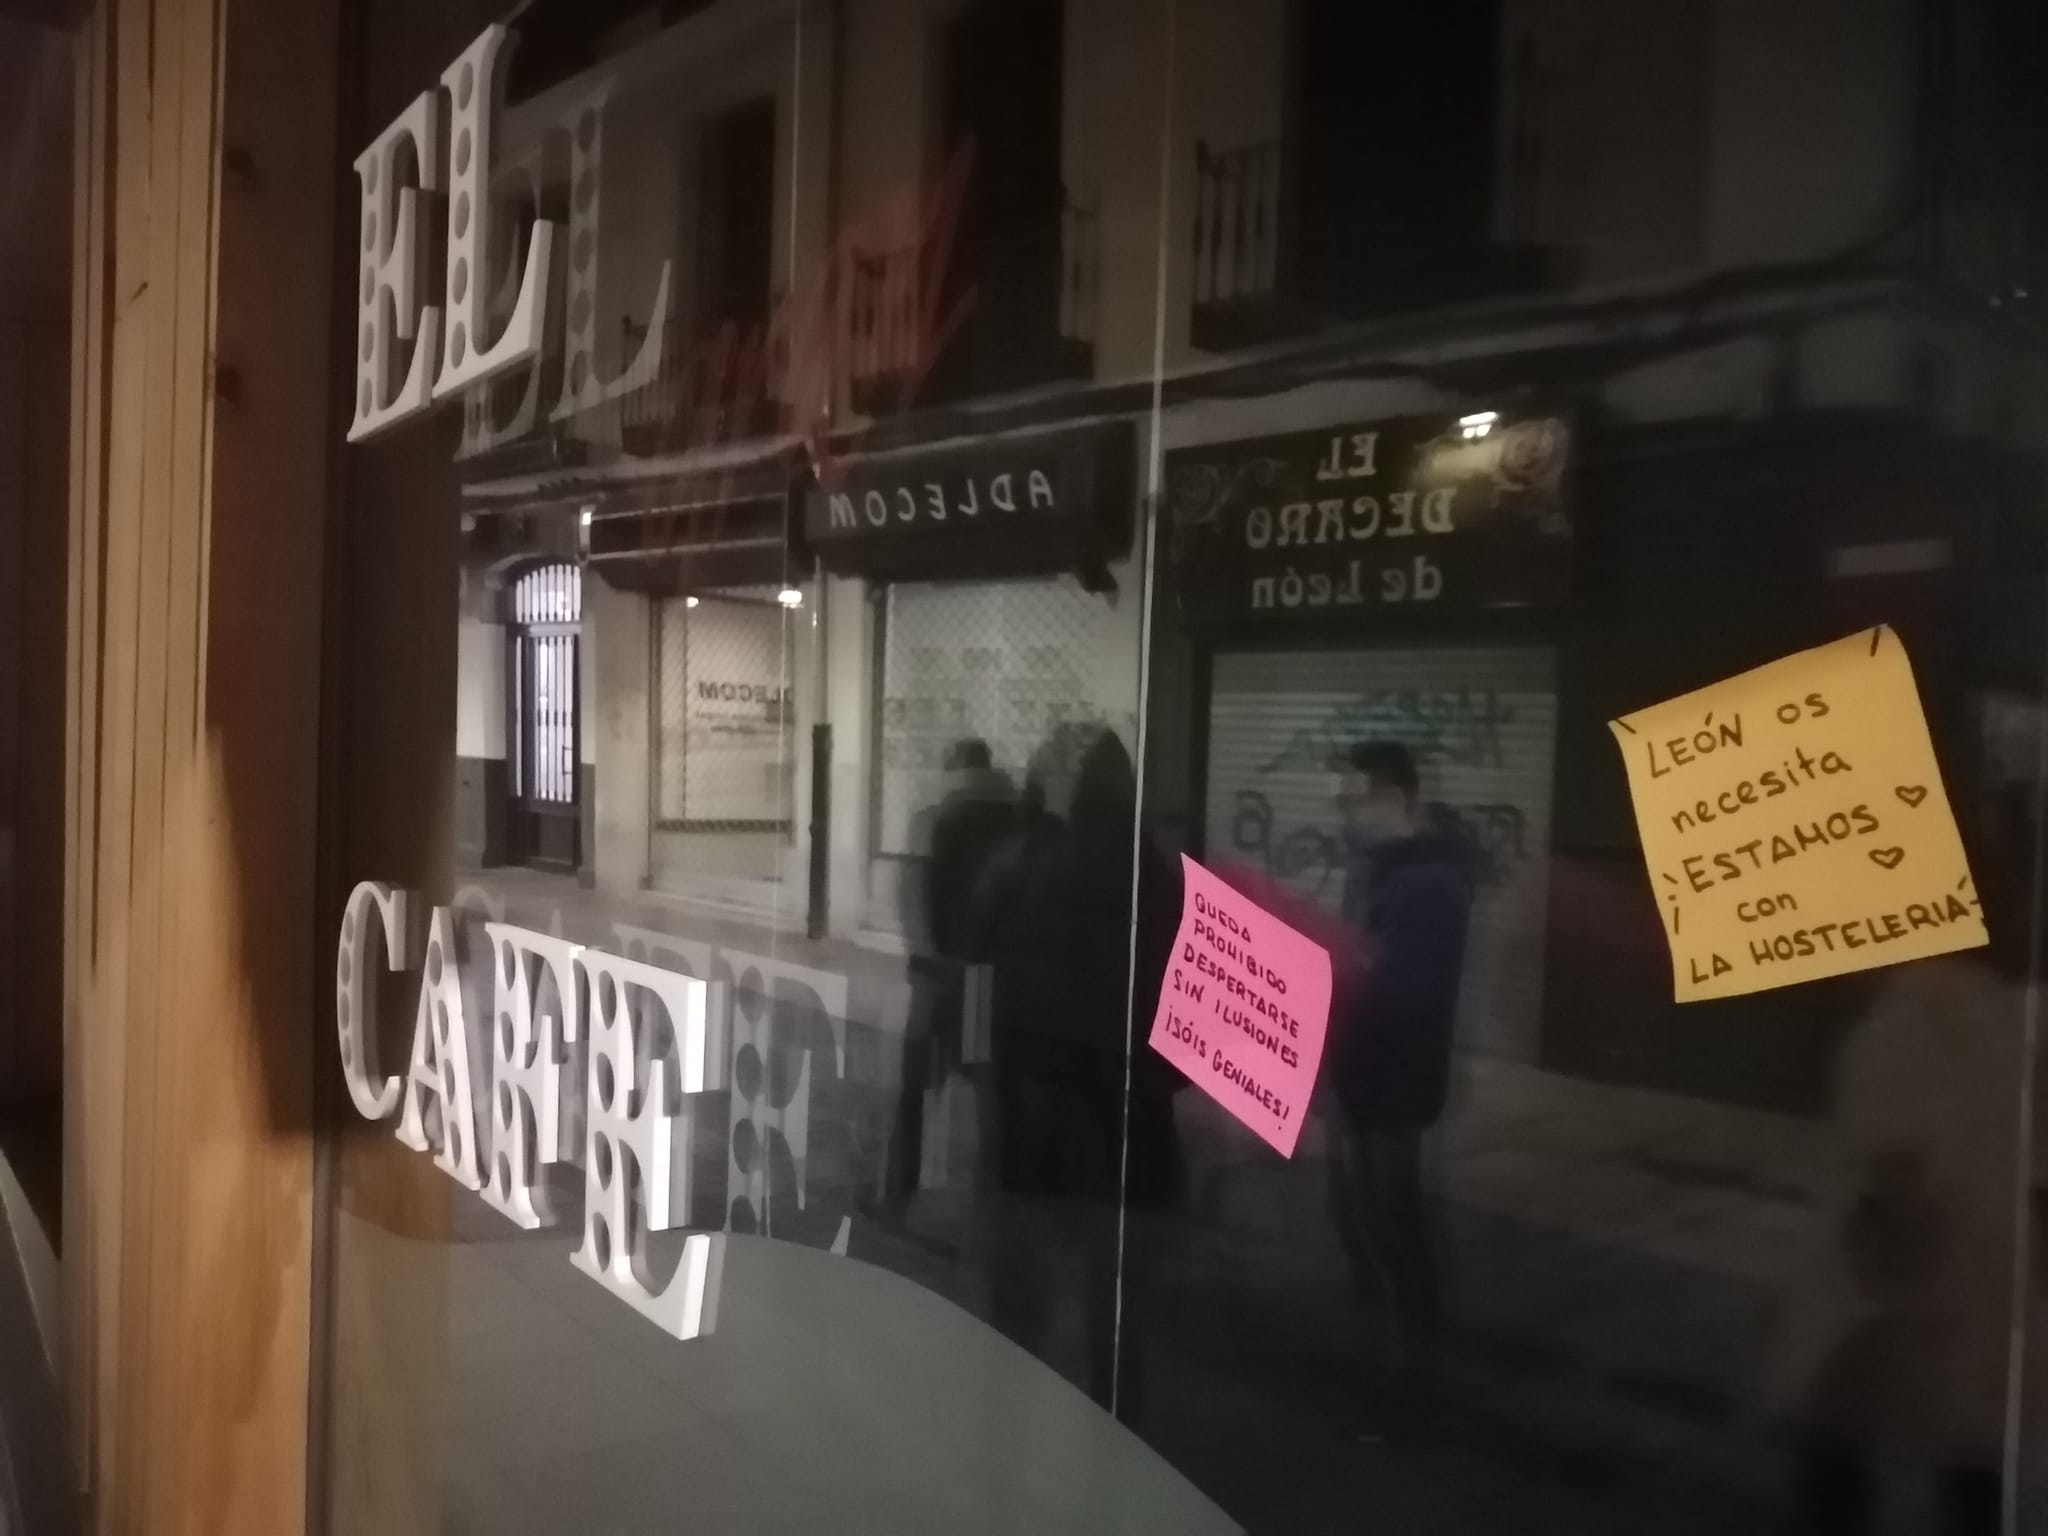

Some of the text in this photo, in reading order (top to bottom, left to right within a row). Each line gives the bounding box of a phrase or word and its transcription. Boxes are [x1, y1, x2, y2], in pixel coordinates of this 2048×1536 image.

[347, 23, 553, 442] EL
[1648, 711, 1744, 778] LEÓN
[1671, 746, 1853, 834] necesita
[1194, 892, 1252, 944] QUEDA
[1736, 893, 1798, 923] con
[1183, 942, 1300, 1039] DESPERTARSE
[1194, 918, 1287, 995] PROHIBIDO
[1690, 953, 1733, 985] LA
[1173, 968, 1299, 1069] SIN ILUSIONES
[336, 881, 710, 1341] CAFE
[1212, 1049, 1291, 1131] GENIALES!
